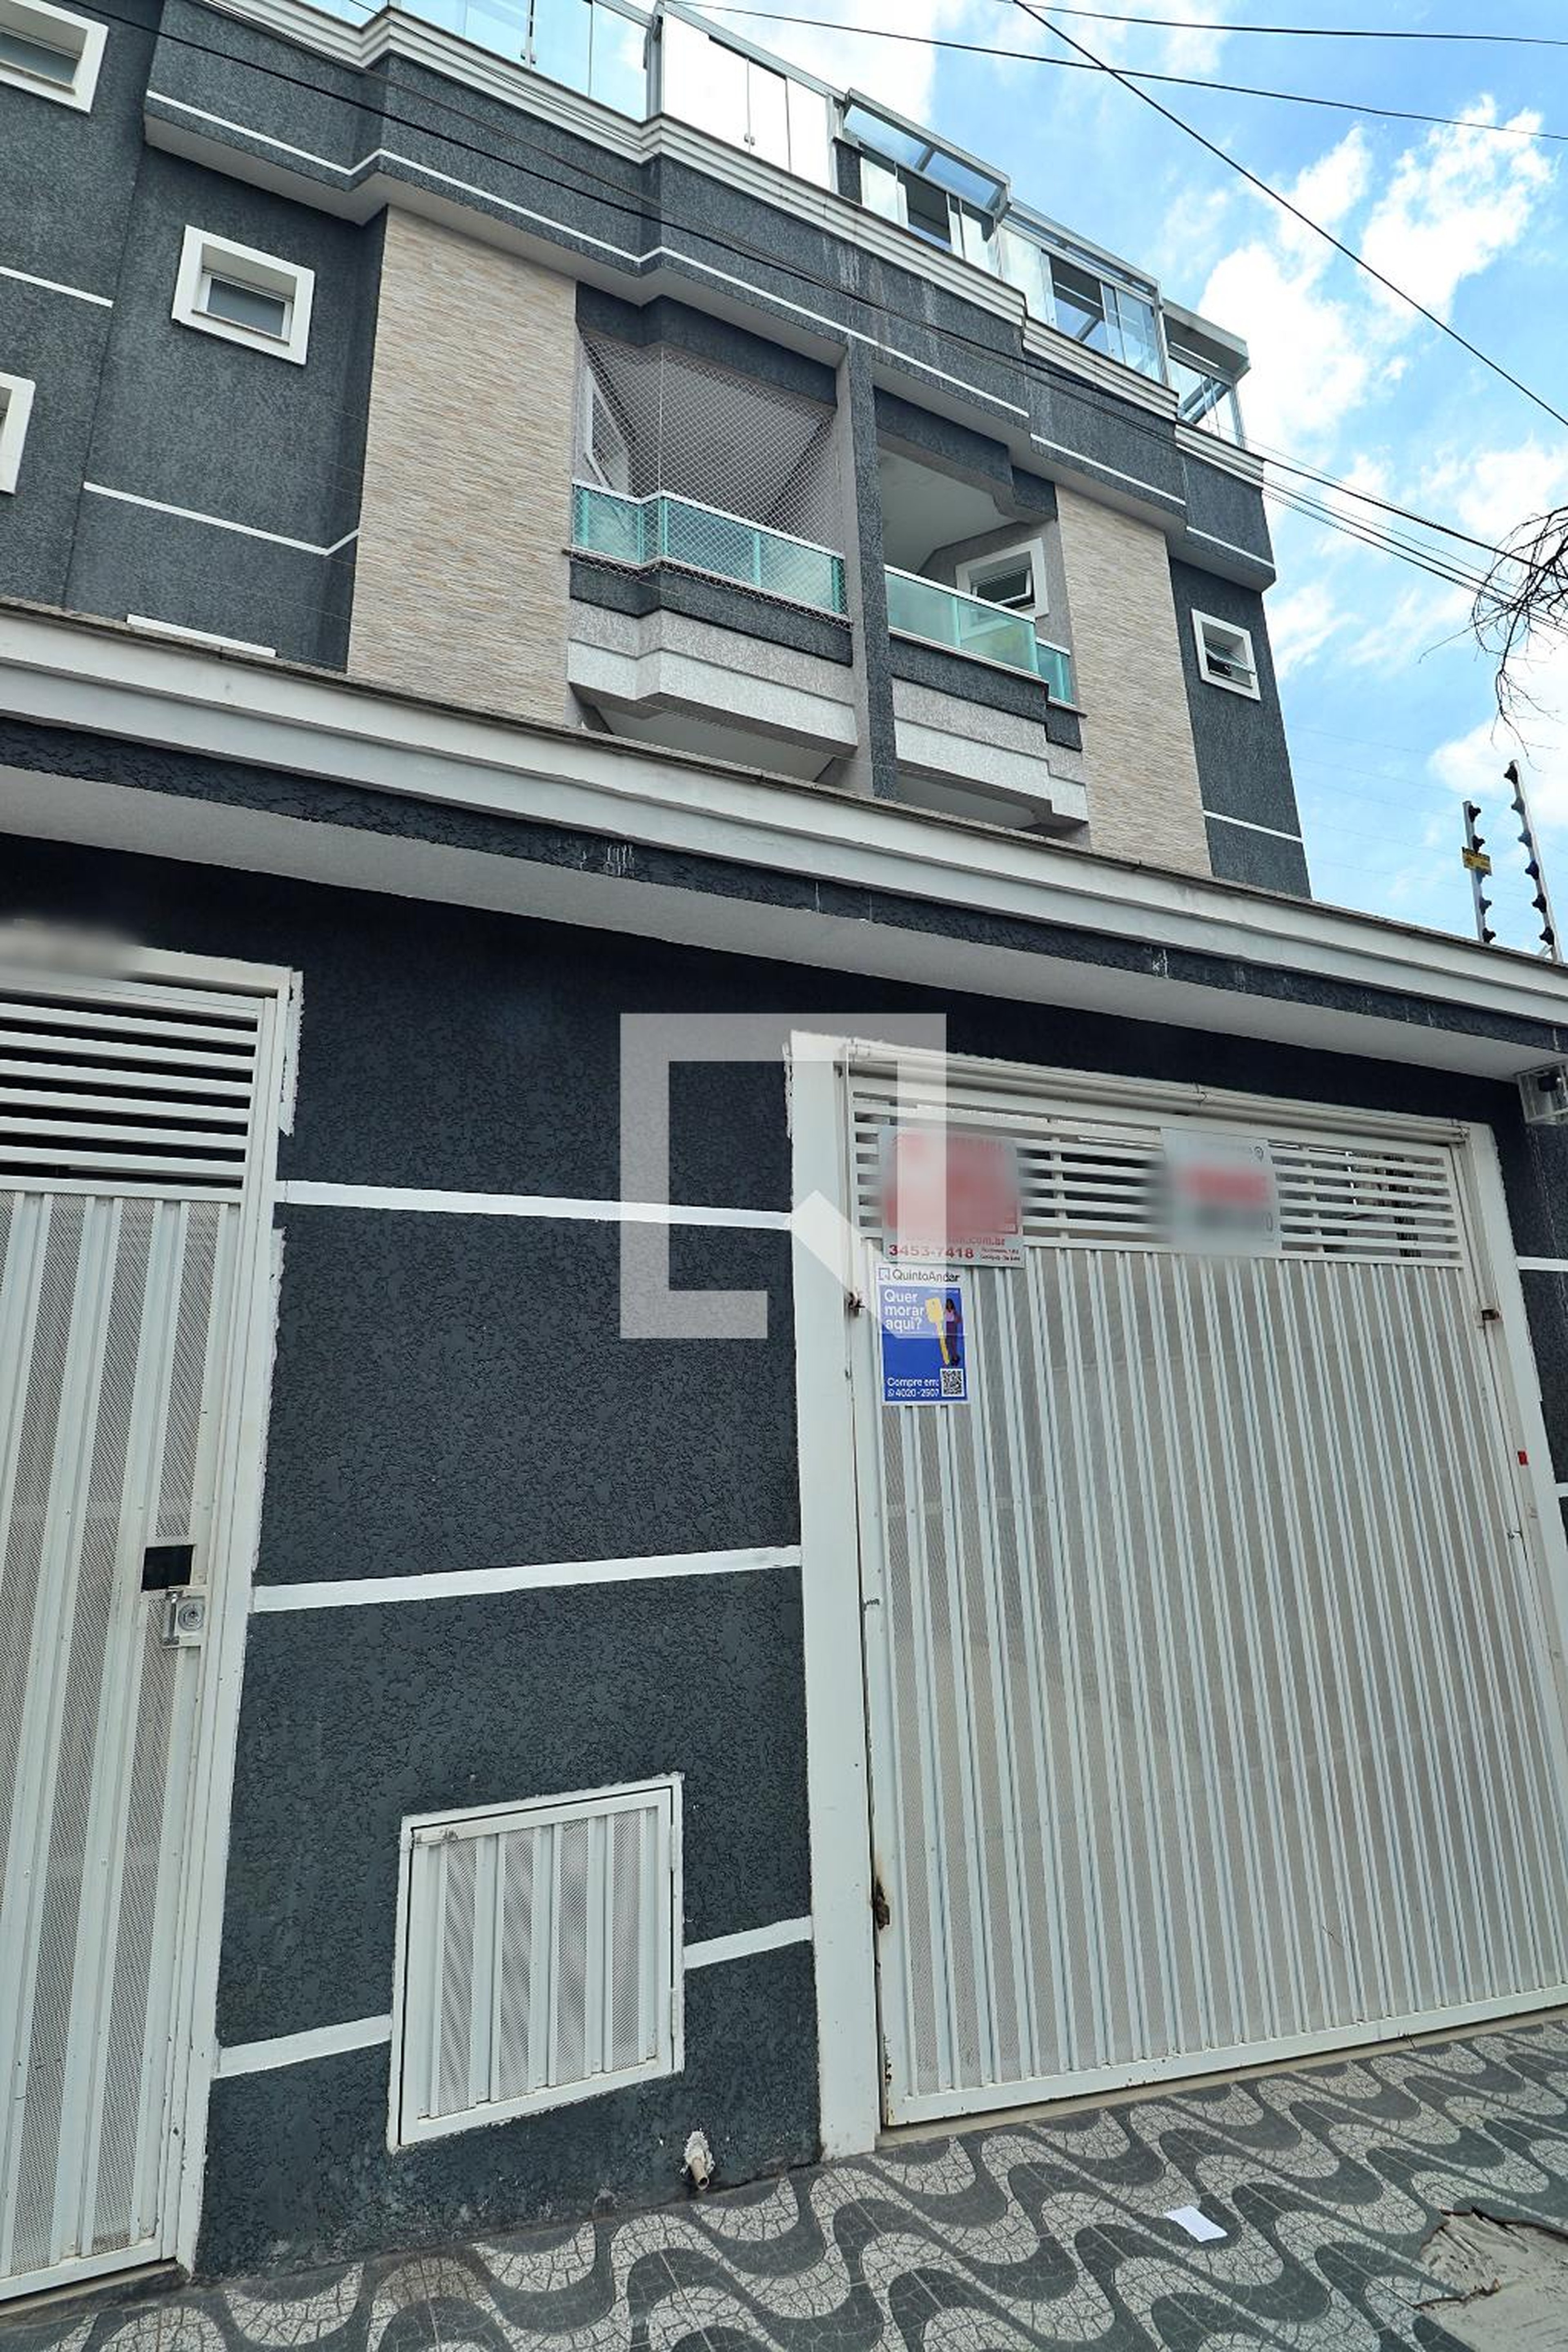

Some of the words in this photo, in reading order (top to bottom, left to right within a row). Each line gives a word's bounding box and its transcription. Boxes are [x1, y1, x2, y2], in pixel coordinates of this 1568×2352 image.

[889, 1244, 974, 1259] 3453-7418
[892, 1268, 960, 1282] QuintoAndar
[884, 1289, 918, 1303] Quer
[884, 1305, 924, 1316] morar
[885, 1316, 922, 1333] aqui?
[887, 1377, 922, 1387] Compre
